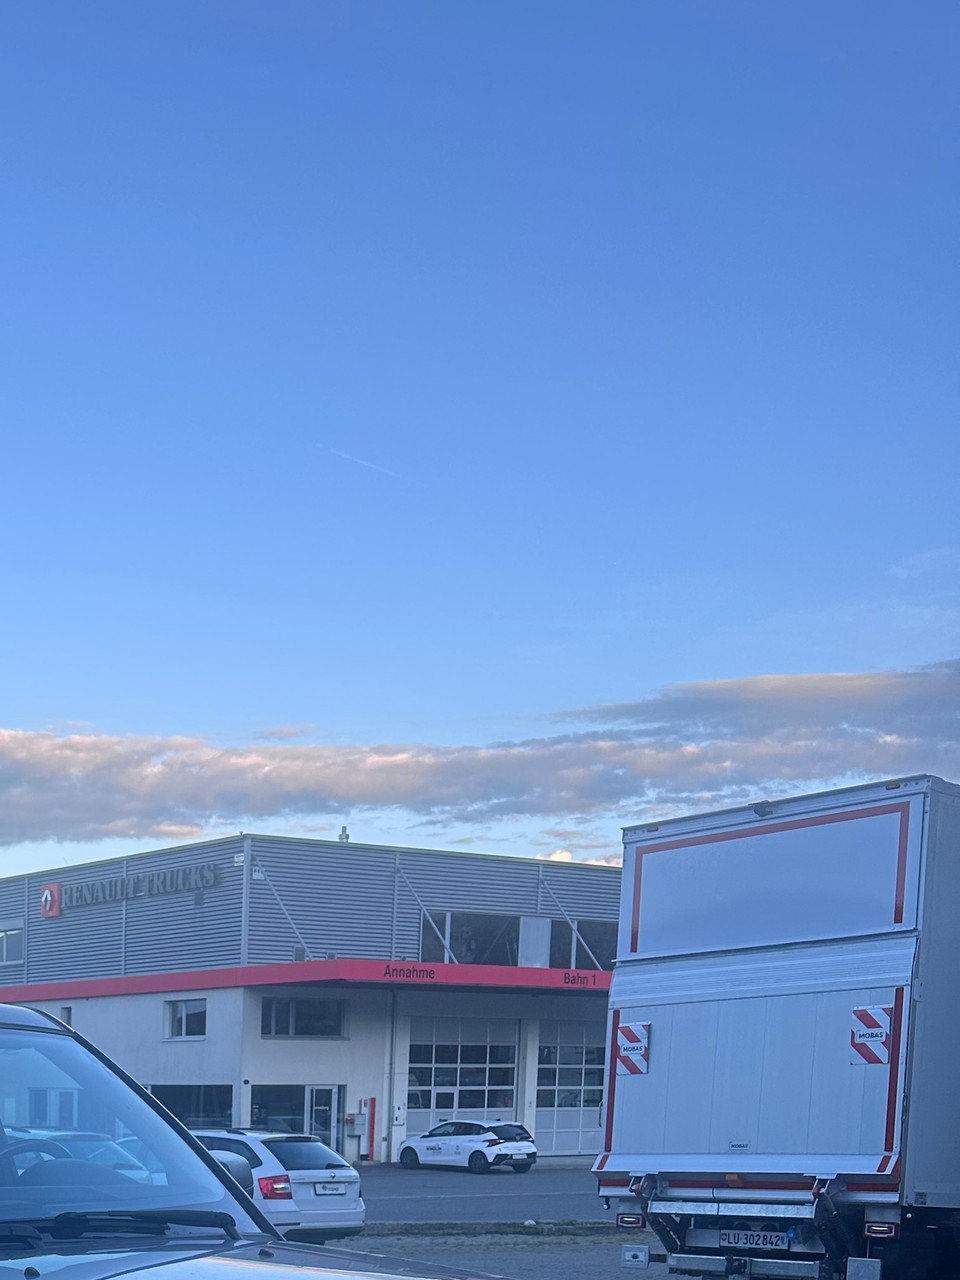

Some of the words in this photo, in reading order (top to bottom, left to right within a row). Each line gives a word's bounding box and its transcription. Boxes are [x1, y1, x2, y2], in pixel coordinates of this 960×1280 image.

[61, 876, 137, 909] RENAULT
[140, 863, 217, 897] TRUCKS
[383, 965, 435, 979] Annahme
[563, 972, 589, 985] Bahn
[858, 1031, 885, 1039] MOBAS
[727, 1232, 740, 1244] LU
